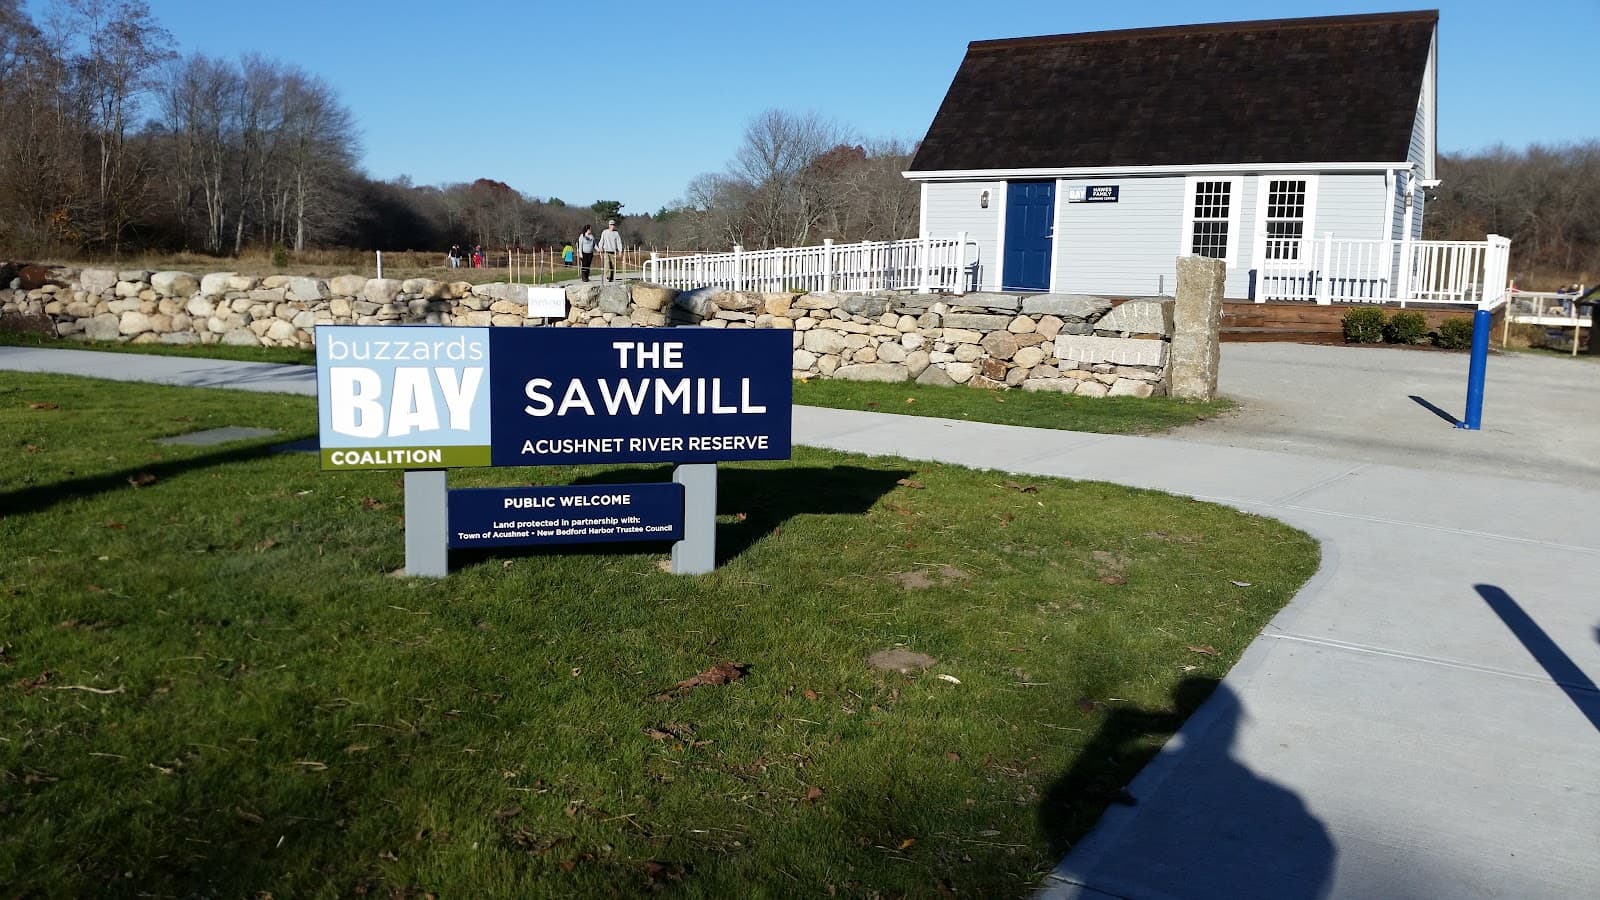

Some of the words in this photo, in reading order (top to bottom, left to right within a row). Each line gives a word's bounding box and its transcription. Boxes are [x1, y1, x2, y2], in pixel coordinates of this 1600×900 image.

[328, 334, 483, 361] buzzards
[612, 342, 684, 369] THE
[330, 367, 484, 438] BAY
[524, 377, 767, 417] SAWMILL
[521, 438, 624, 455] ACUSHNET
[629, 437, 683, 452] RIVER
[688, 435, 769, 451] RESERVE
[331, 449, 442, 465] COALITION
[504, 497, 555, 509] PUBLIC
[559, 494, 631, 507] WELCOME
[458, 532, 480, 540] Town
[492, 530, 530, 538] Acushnet
[556, 527, 587, 535] Bedford
[588, 526, 614, 534] Harbor
[645, 524, 673, 532] Council
[493, 520, 515, 529] Land
[517, 519, 560, 529] protected
[561, 518, 569, 526] in
[571, 517, 618, 526] partnership
[620, 516, 641, 524] with:
